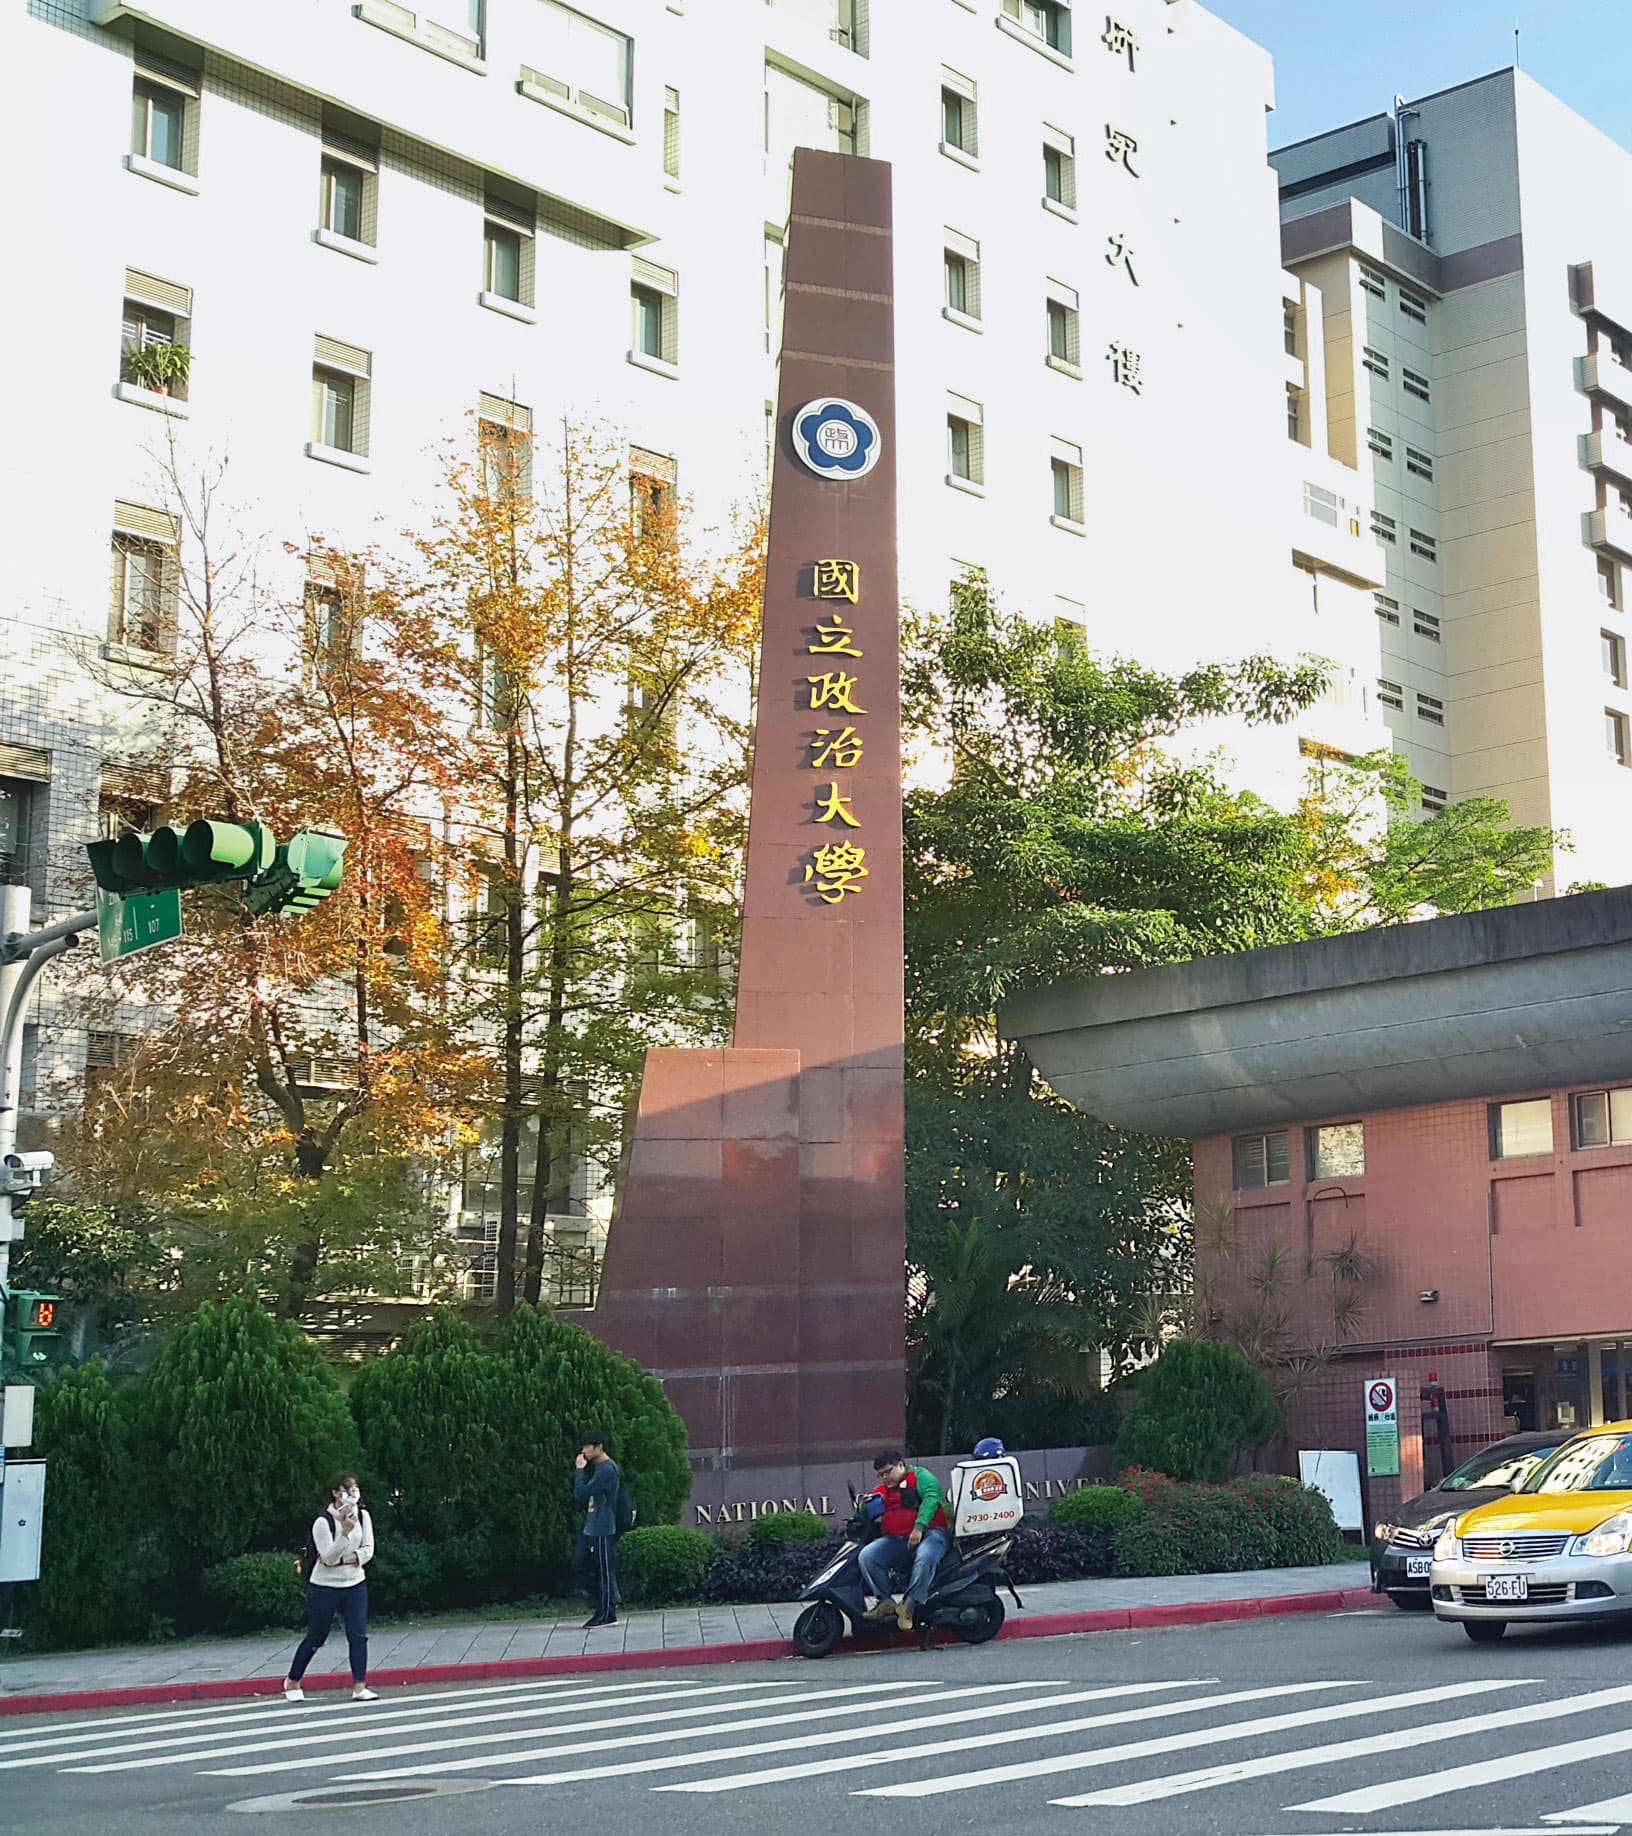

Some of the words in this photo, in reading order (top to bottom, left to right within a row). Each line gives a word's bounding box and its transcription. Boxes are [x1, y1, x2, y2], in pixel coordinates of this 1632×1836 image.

[804, 558, 870, 904] 國立政治大學
[147, 918, 160, 935] 107
[695, 1495, 836, 1525] NATIONAL
[966, 1510, 1015, 1523] 2930-2400
